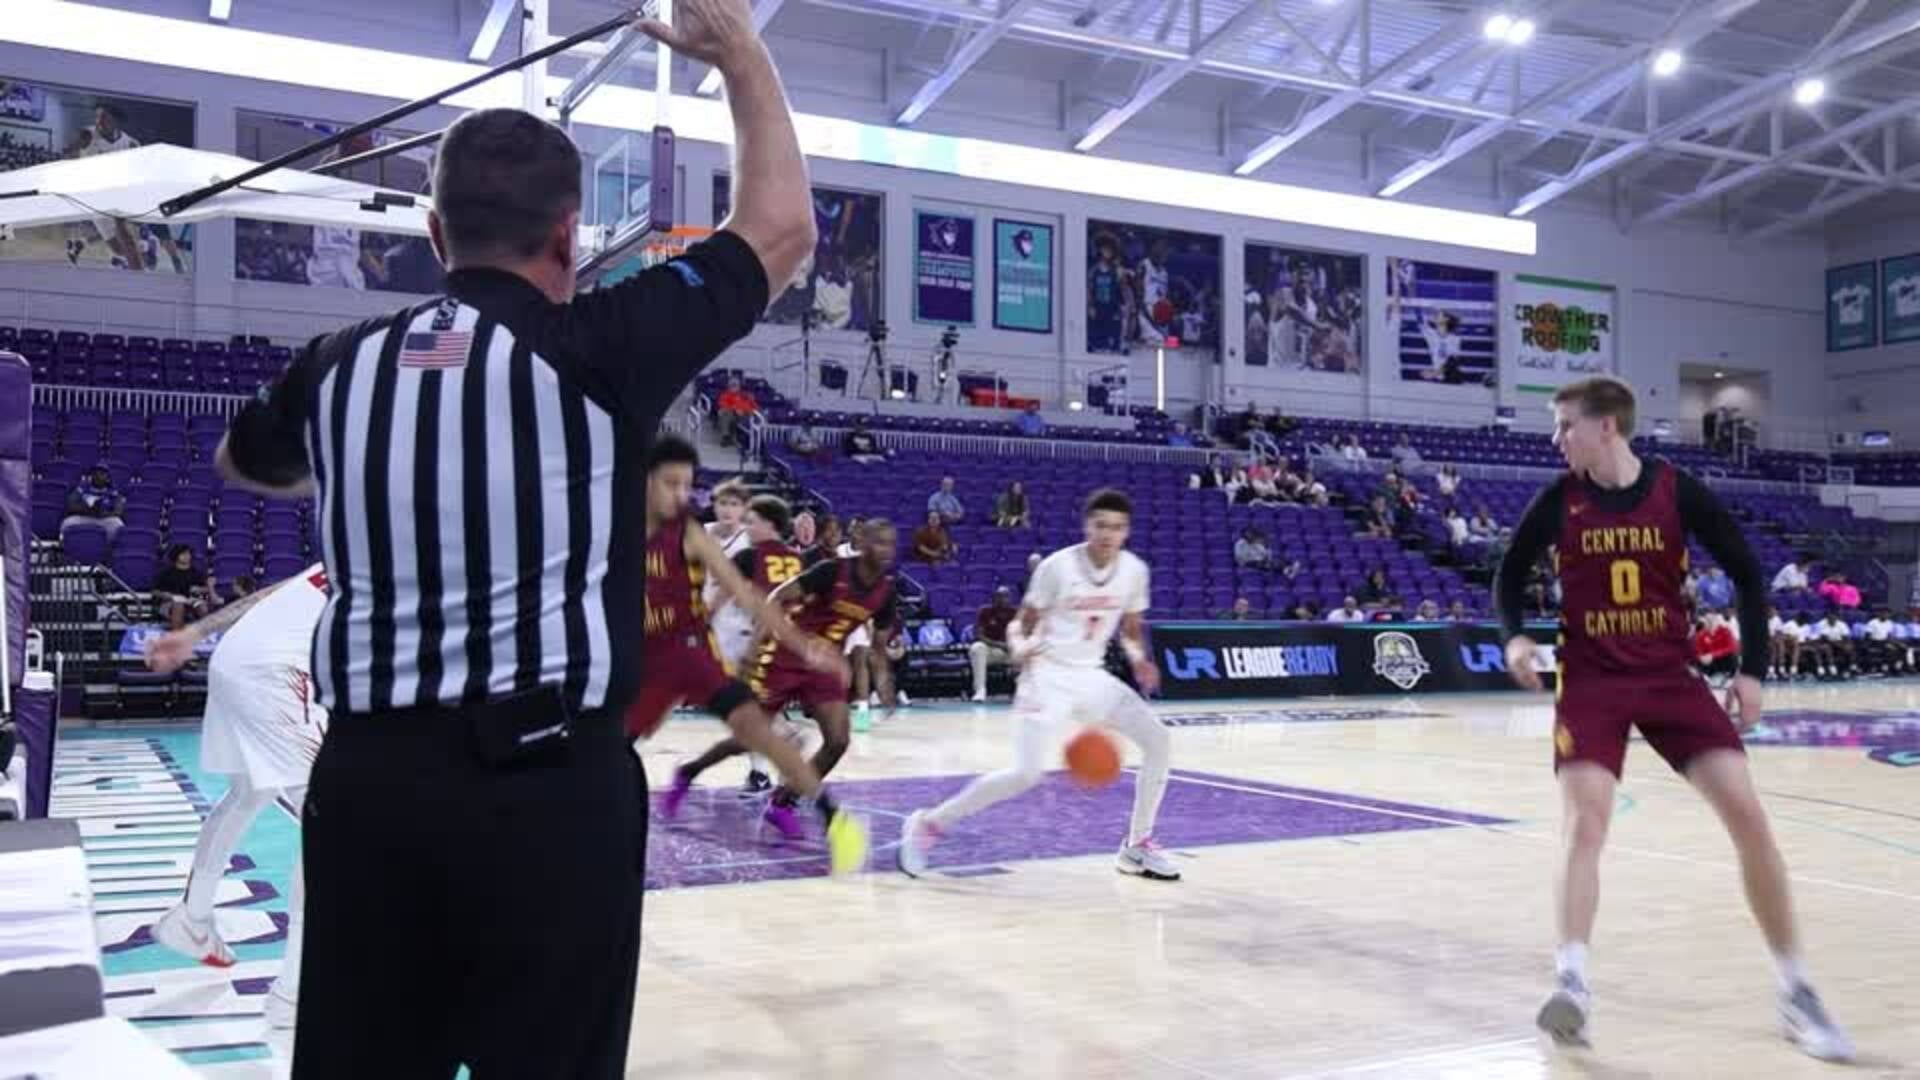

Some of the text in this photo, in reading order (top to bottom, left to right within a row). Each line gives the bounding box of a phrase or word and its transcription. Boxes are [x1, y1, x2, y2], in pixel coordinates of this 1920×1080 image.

[1521, 327, 1600, 353] ROOFING
[1582, 526, 1665, 555] CENTRAL
[1611, 559, 1640, 605] 0
[1585, 606, 1667, 637] CATHOLIC
